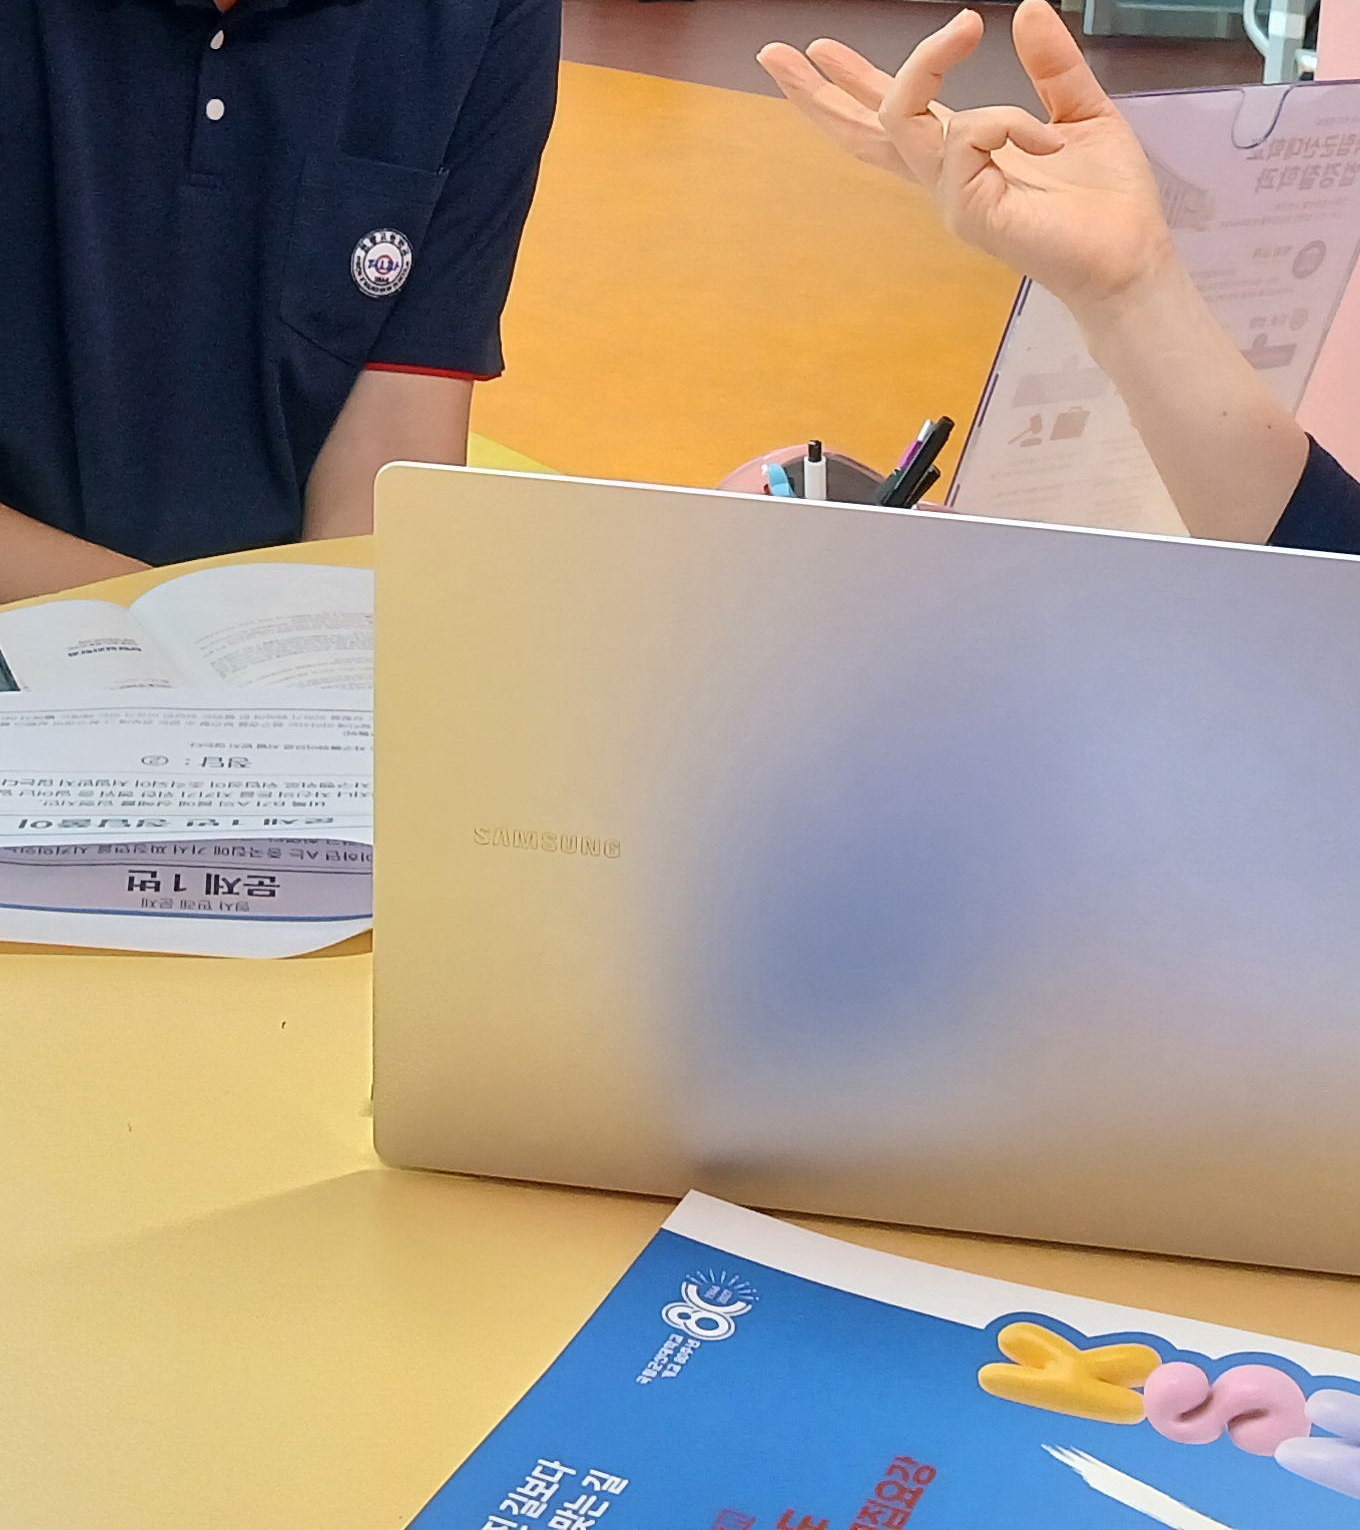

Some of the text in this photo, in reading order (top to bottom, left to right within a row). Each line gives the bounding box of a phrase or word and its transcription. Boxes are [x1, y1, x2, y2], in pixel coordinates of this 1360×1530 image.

[202, 756, 252, 768] 정답
[473, 827, 621, 859] SAMSUNG
[127, 869, 281, 898] 문제 1 번
[140, 898, 174, 909] 문제
[499, 1458, 577, 1519] 길보다
[581, 1469, 629, 1495] 길
